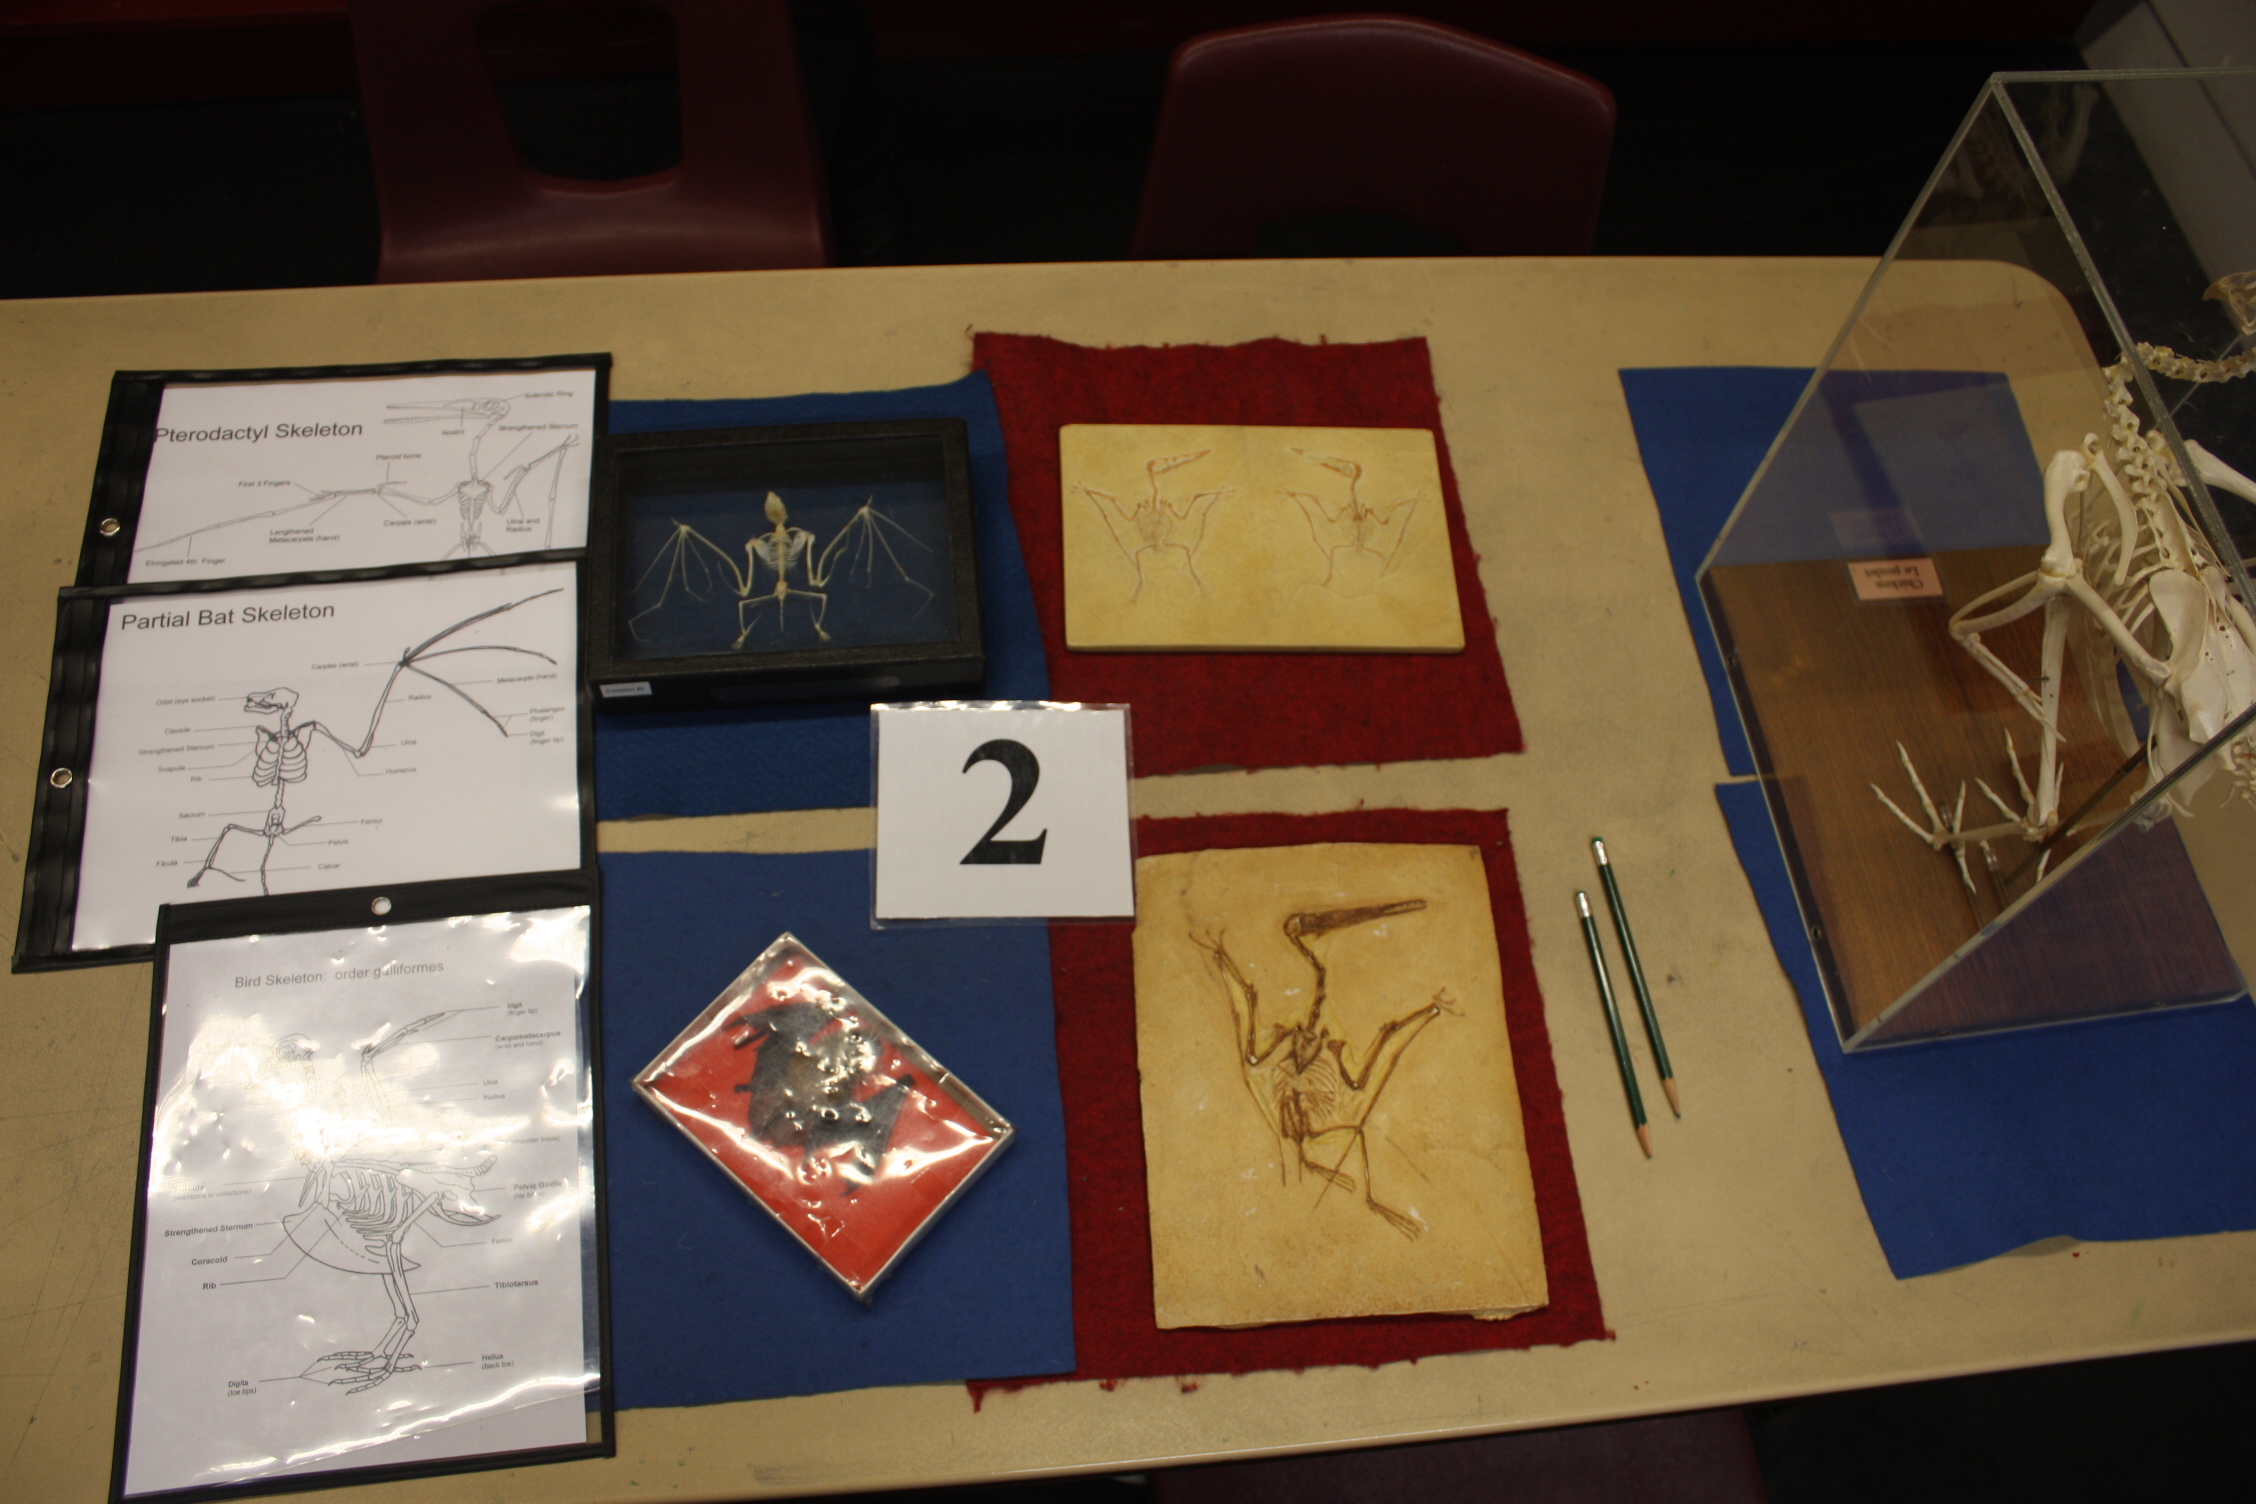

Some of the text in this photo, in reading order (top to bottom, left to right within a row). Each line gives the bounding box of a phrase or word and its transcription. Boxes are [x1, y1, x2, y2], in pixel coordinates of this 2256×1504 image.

[154, 421, 363, 443] Pterodactyl Skeleton
[264, 479, 291, 488] Fingers
[315, 534, 340, 542] (hand)
[202, 556, 226, 566] Finger
[121, 603, 335, 630] Partial Bat Skeleton
[959, 738, 1048, 865] 2
[178, 811, 206, 819] Sacrum
[360, 817, 383, 825] Femur
[171, 835, 188, 843] Tibia
[328, 838, 349, 846] Pelvis
[156, 859, 178, 867] Fibula
[317, 862, 341, 870] Calcar
[234, 962, 444, 988] Bird Skeleton: order galliformes
[513, 1179, 562, 1191] Pelvic Girdle
[164, 1222, 253, 1237] Strengthened Sternum
[191, 1255, 228, 1266] Coracoid
[202, 1282, 217, 1290] Rib
[495, 1279, 539, 1289] Tibiotarsus
[501, 1360, 515, 1368] toe)
[228, 1379, 249, 1388] Digits
